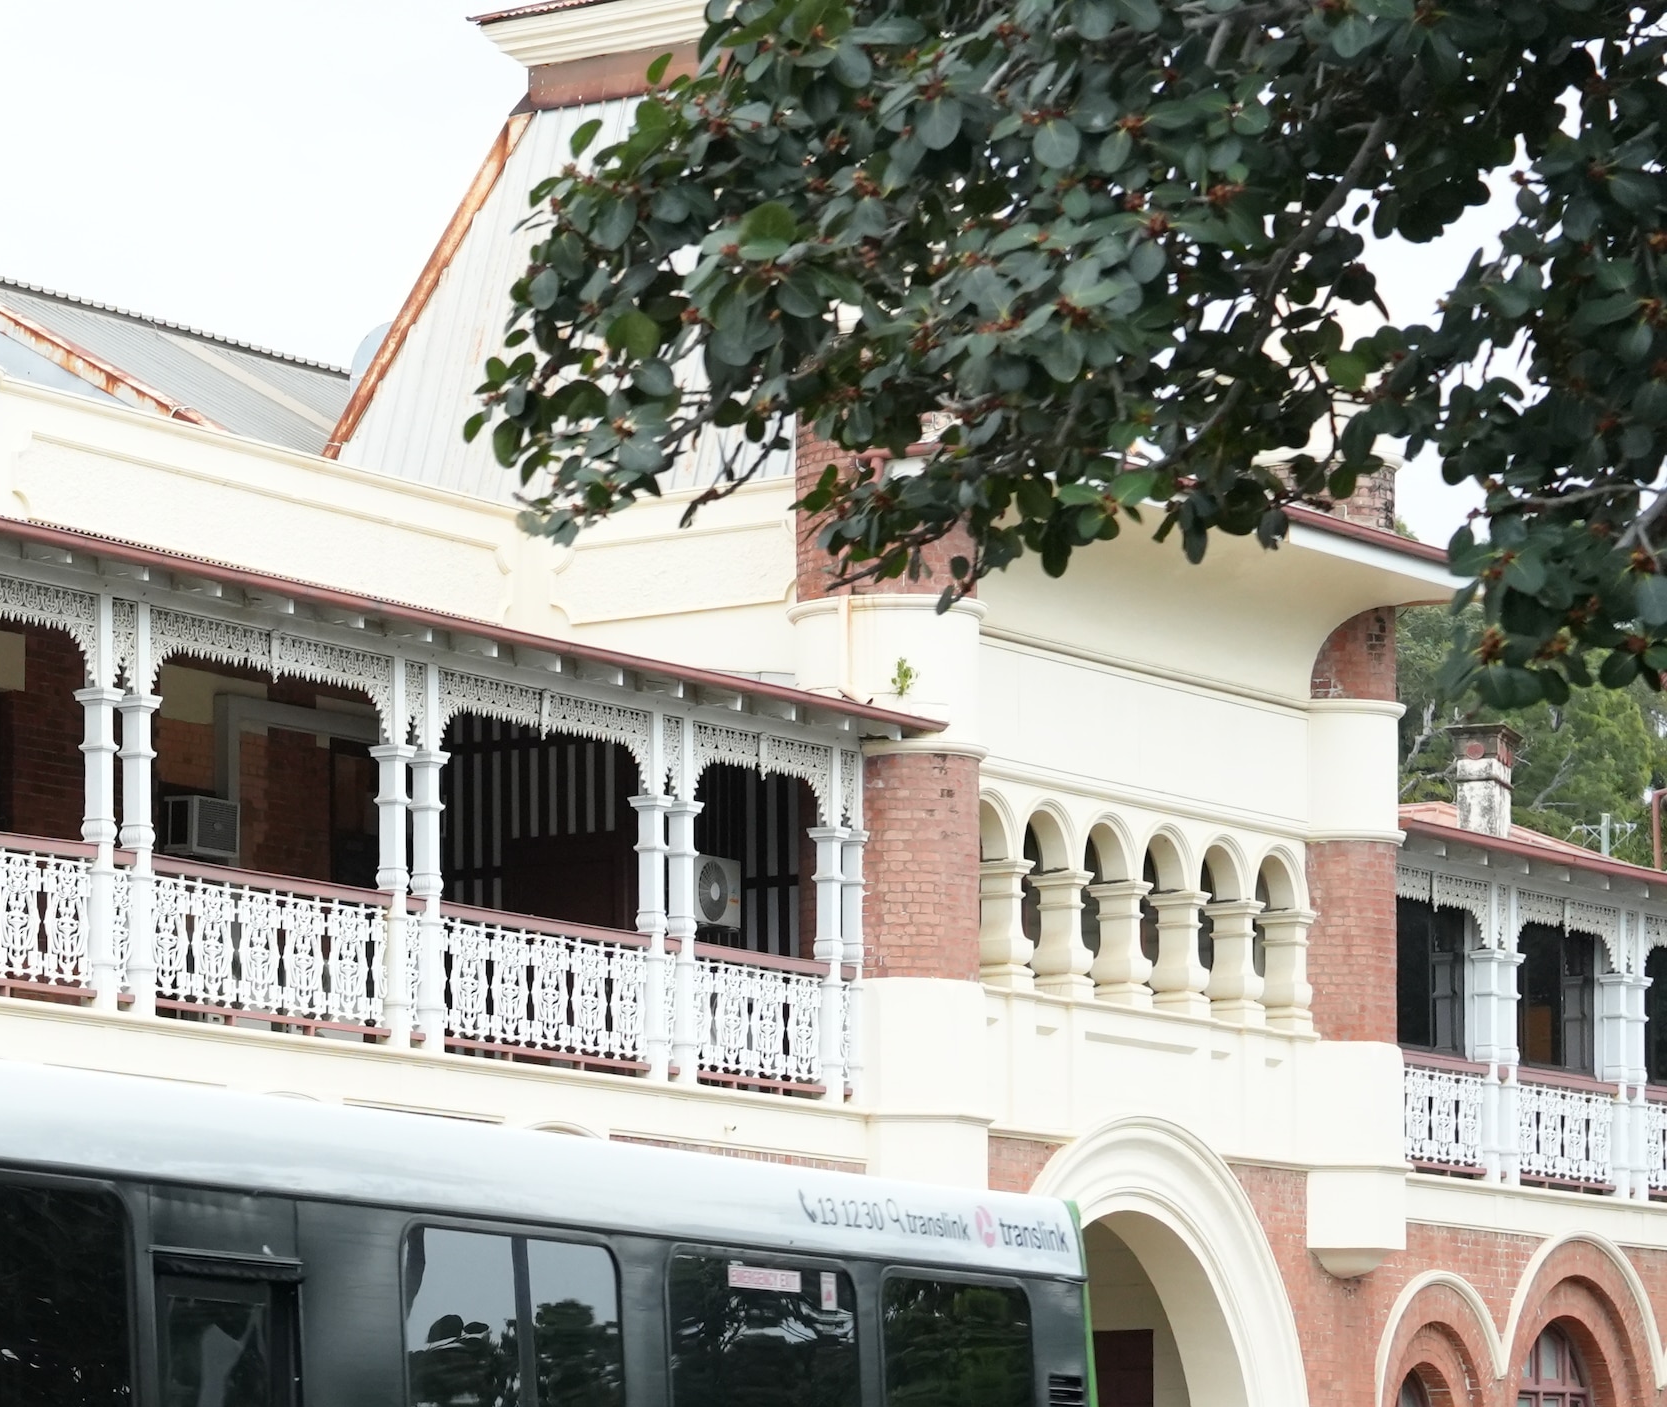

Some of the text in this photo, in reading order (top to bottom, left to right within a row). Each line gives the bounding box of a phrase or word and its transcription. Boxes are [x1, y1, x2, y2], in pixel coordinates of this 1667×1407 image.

[818, 1198, 838, 1226] 13
[905, 1209, 971, 1241] translink
[998, 1217, 1070, 1252] translink
